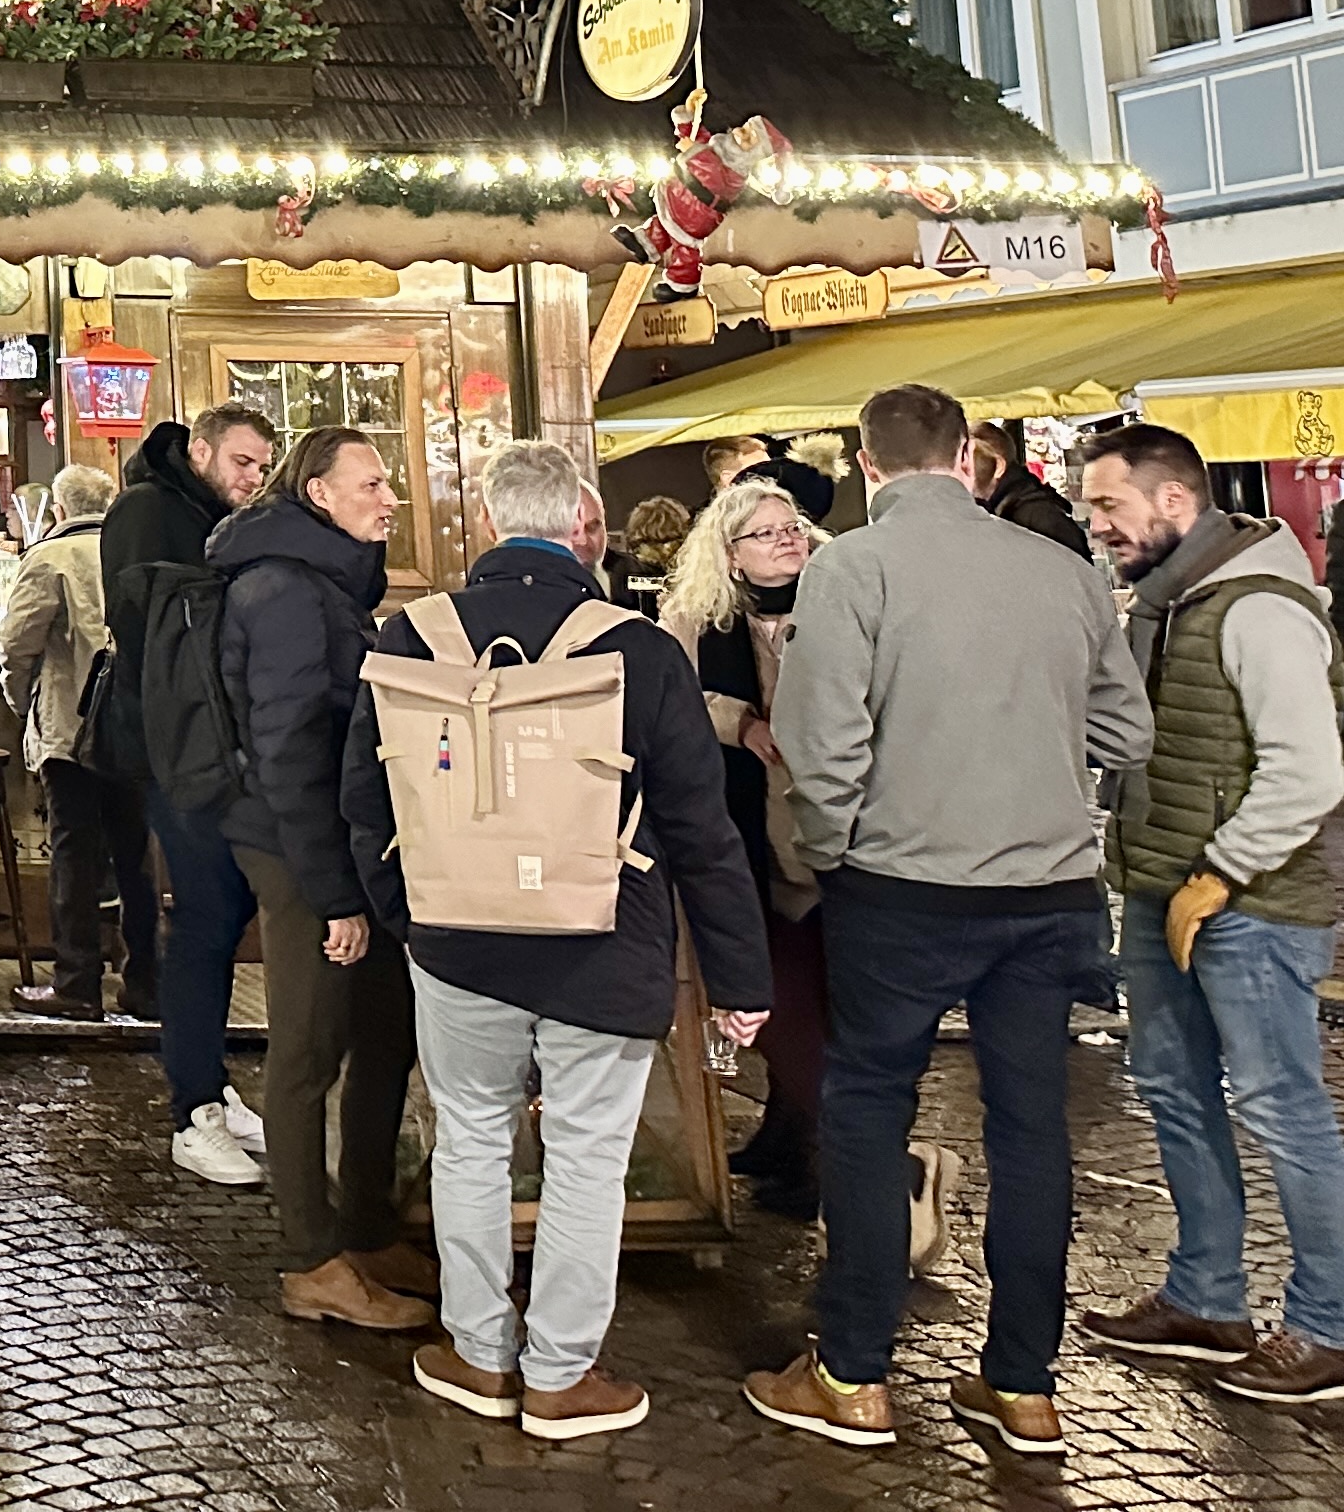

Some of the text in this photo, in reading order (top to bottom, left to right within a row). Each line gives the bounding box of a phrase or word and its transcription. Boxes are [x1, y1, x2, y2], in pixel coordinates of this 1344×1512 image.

[597, 18, 675, 65] Am Kamin
[1005, 235, 1066, 259] M16
